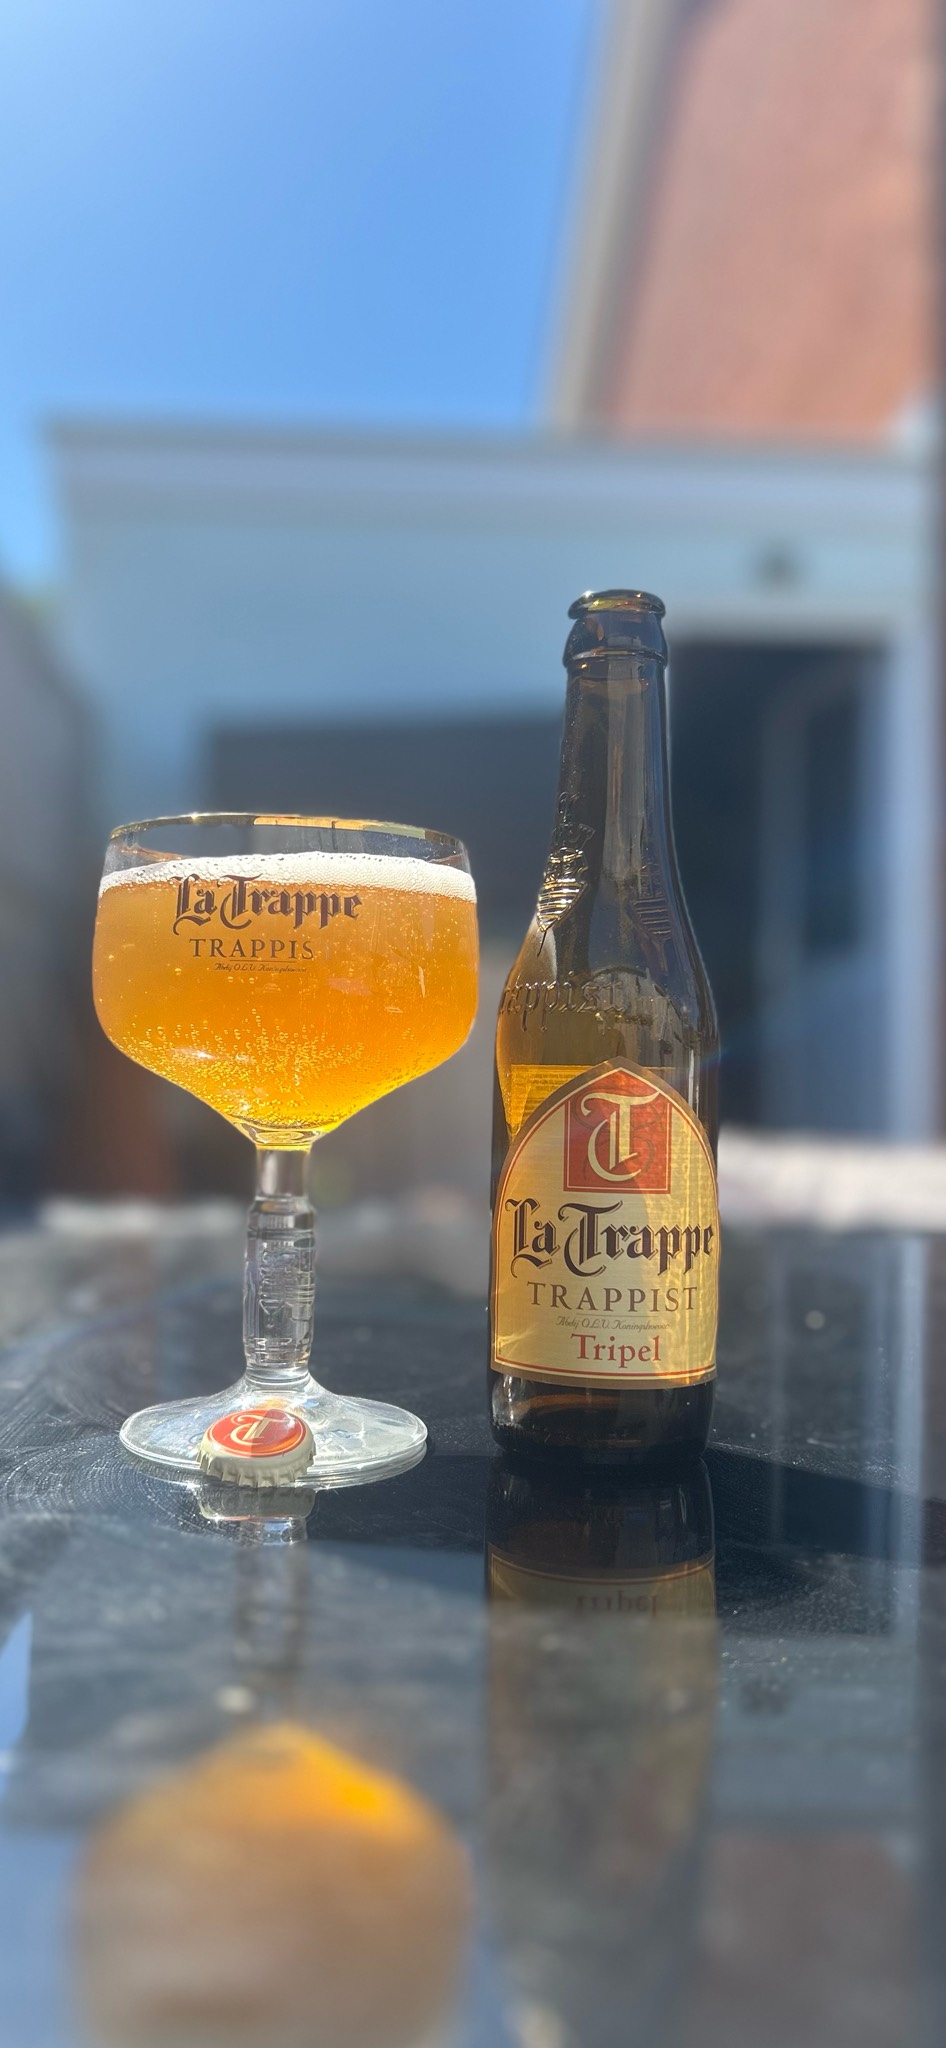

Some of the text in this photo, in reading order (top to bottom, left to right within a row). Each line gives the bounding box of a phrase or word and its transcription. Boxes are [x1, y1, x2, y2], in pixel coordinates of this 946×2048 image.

[171, 873, 362, 935] La Trappe
[189, 938, 331, 960] TRAPPIS
[505, 1198, 714, 1278] La Trappe
[527, 1281, 698, 1312] TRAPPIST
[570, 1333, 662, 1368] Tripel
